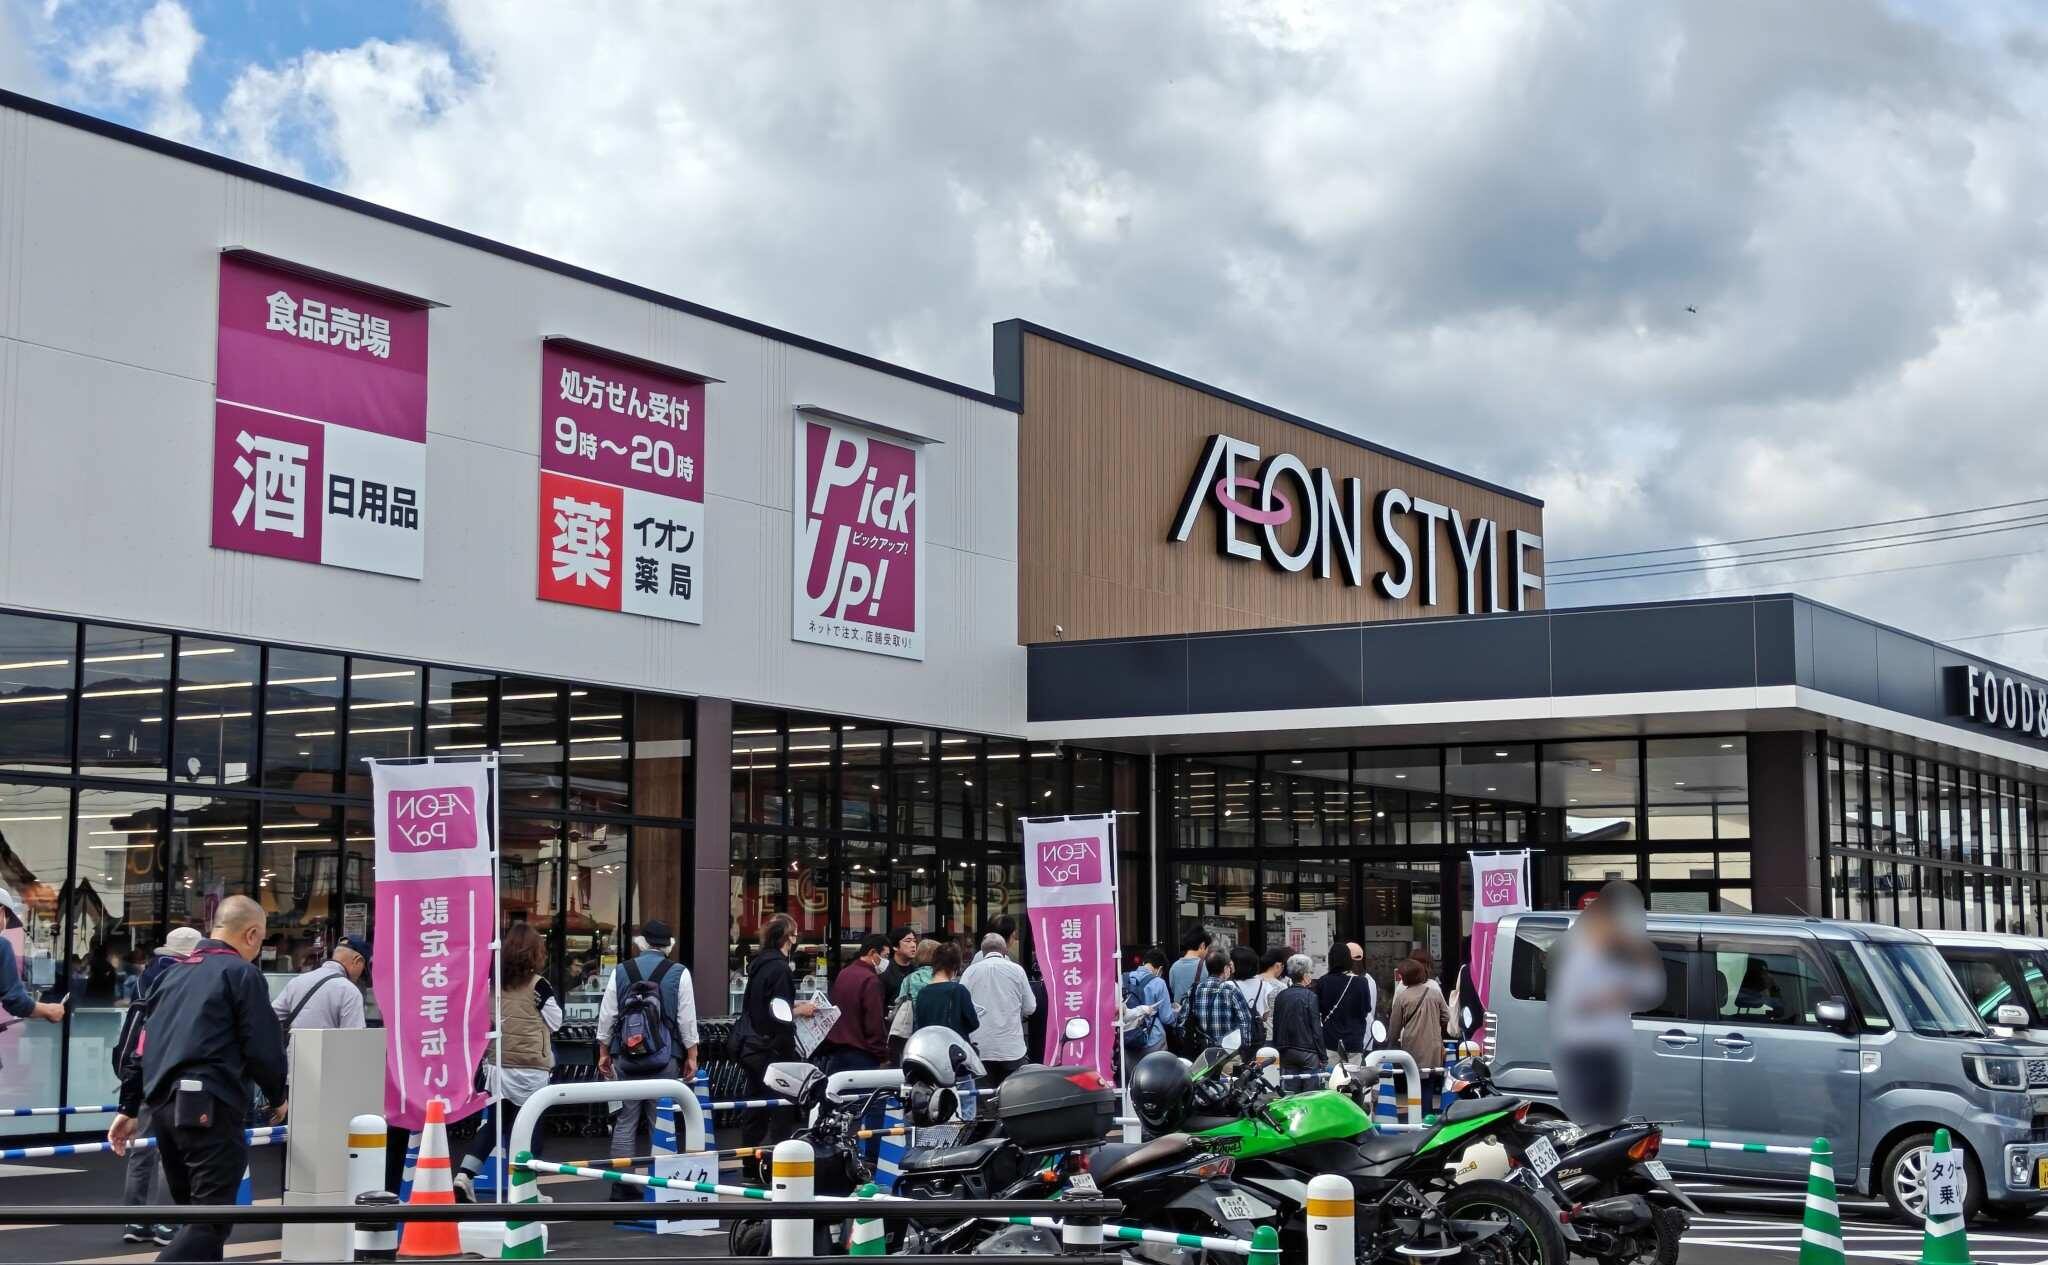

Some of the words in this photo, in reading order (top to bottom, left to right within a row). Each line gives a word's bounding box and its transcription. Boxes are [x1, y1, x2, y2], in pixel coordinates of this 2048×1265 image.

[265, 290, 391, 359] 食品売場
[560, 367, 690, 431] 処方せん受付
[231, 429, 309, 539] 酒
[328, 473, 419, 530] 日用品
[811, 426, 916, 534] Pick
[551, 495, 612, 590] 薬
[633, 517, 695, 553] イオン
[801, 518, 890, 621] Up!
[635, 556, 692, 601] 薬局
